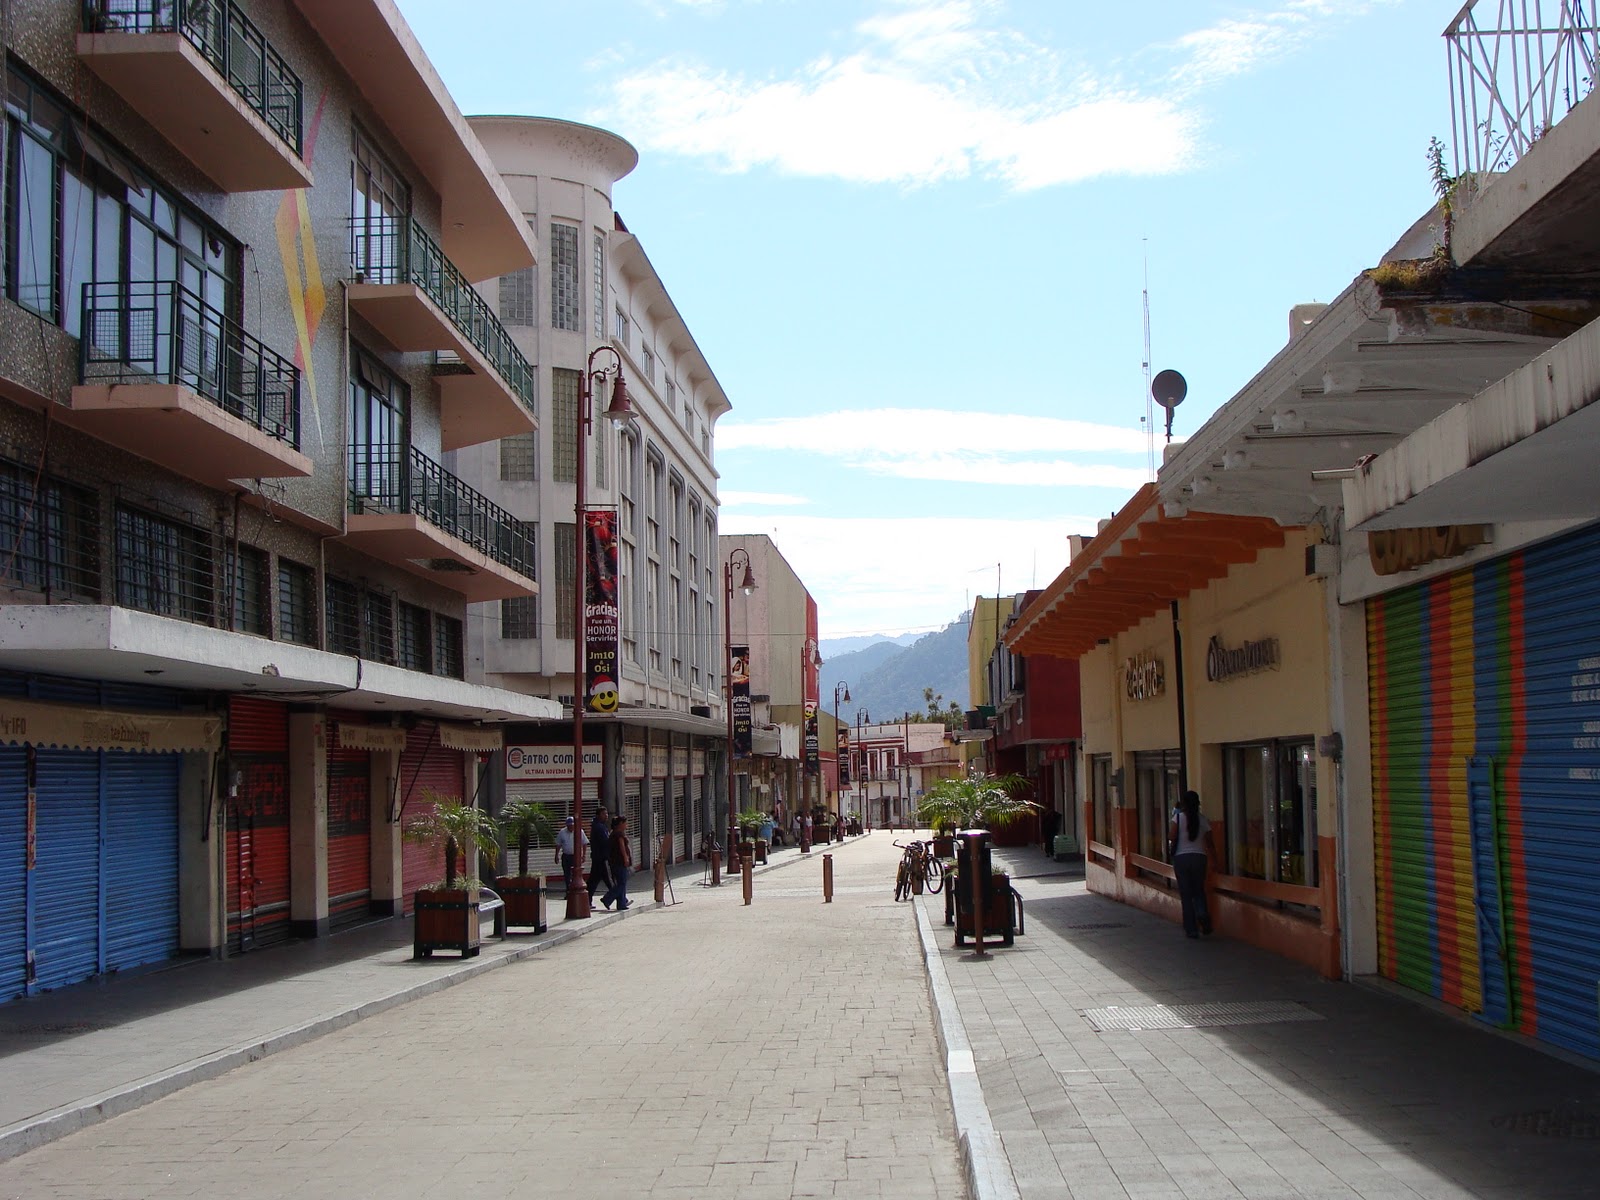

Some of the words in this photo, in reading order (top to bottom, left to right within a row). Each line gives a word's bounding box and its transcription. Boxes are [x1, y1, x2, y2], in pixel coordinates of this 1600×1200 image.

[586, 602, 618, 617] Gracias
[587, 626, 617, 635] HONOR
[594, 664, 610, 673] Osi
[508, 747, 549, 769] CENTRO
[552, 753, 602, 764] COMCIAL
